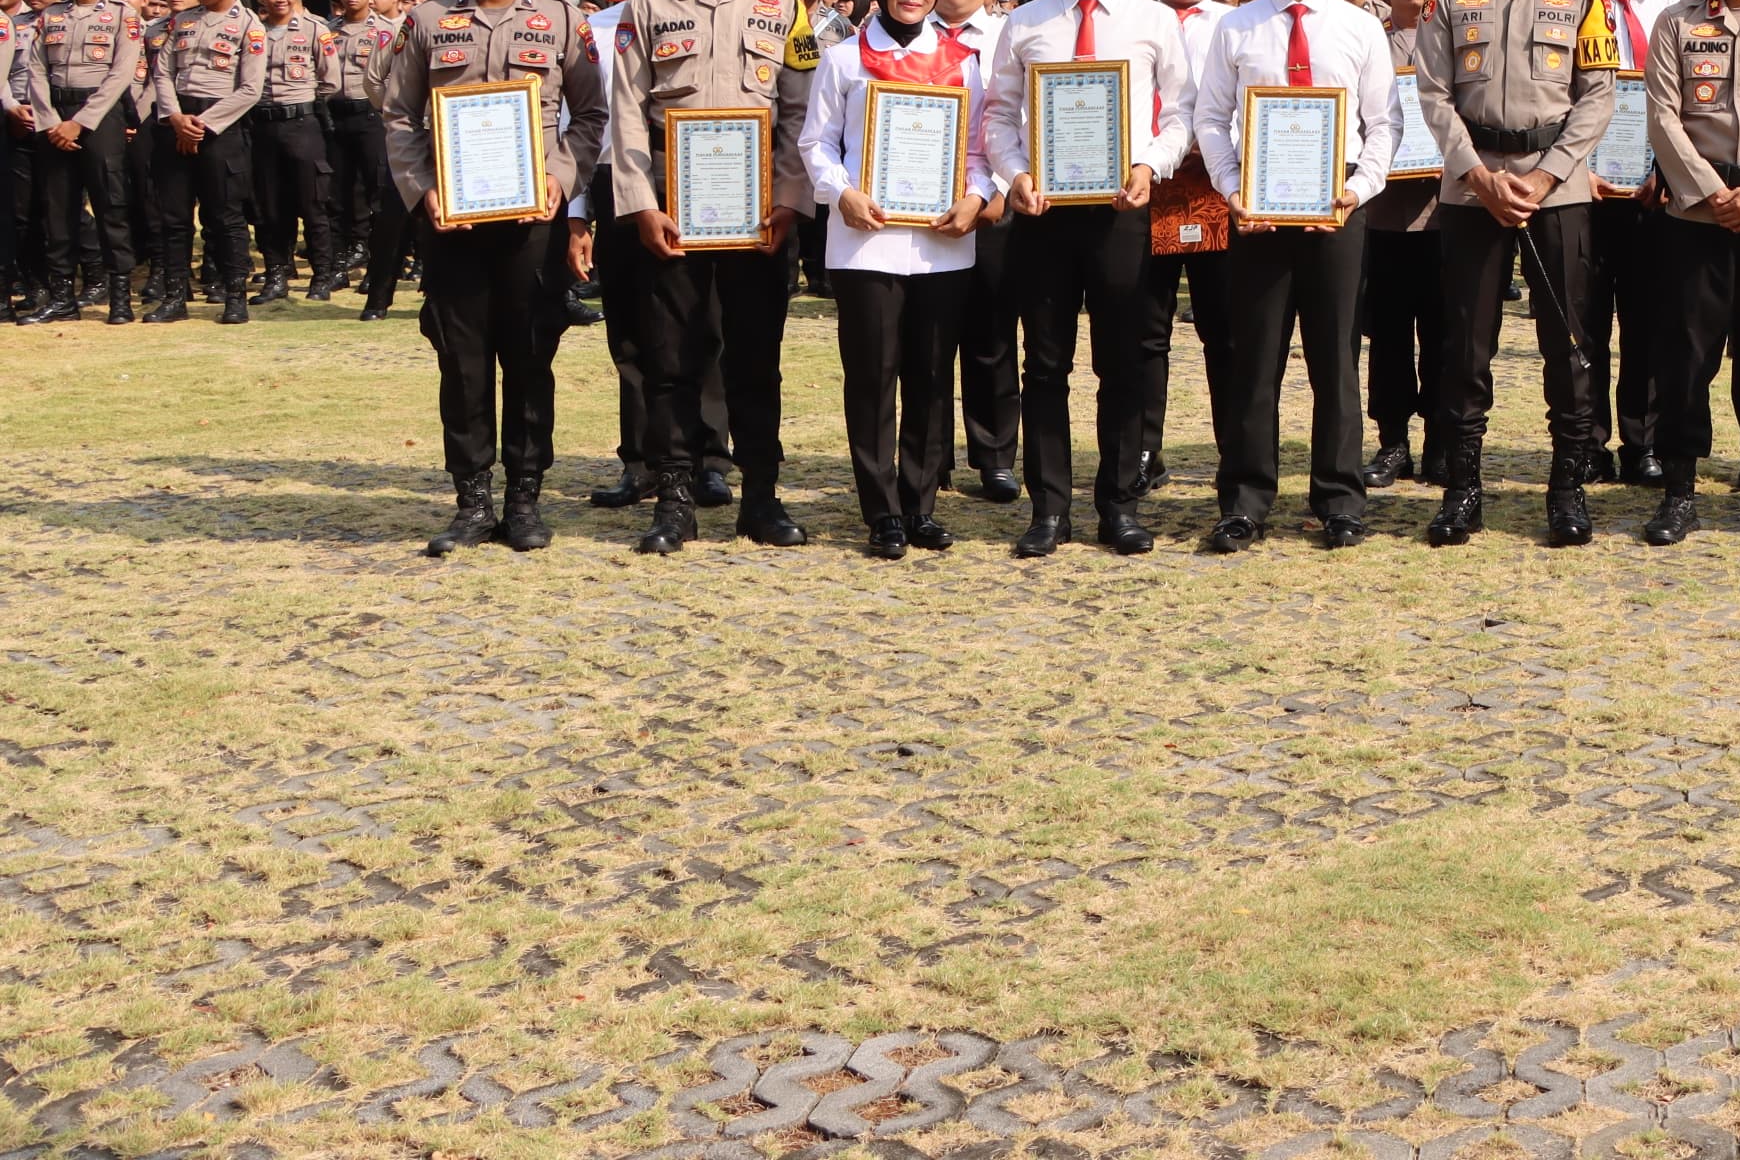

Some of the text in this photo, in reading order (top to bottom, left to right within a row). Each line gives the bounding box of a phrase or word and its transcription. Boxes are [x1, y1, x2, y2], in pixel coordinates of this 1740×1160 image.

[1461, 11, 1482, 22] ARI
[1538, 11, 1576, 24] POLRI
[87, 25, 115, 34] POLRI
[654, 20, 695, 36] SADAD
[747, 18, 787, 36] POLRI
[432, 32, 474, 45] YUDHA
[514, 32, 556, 45] POLRI
[1583, 39, 1602, 64] KA
[1683, 40, 1729, 54] ALDINO
